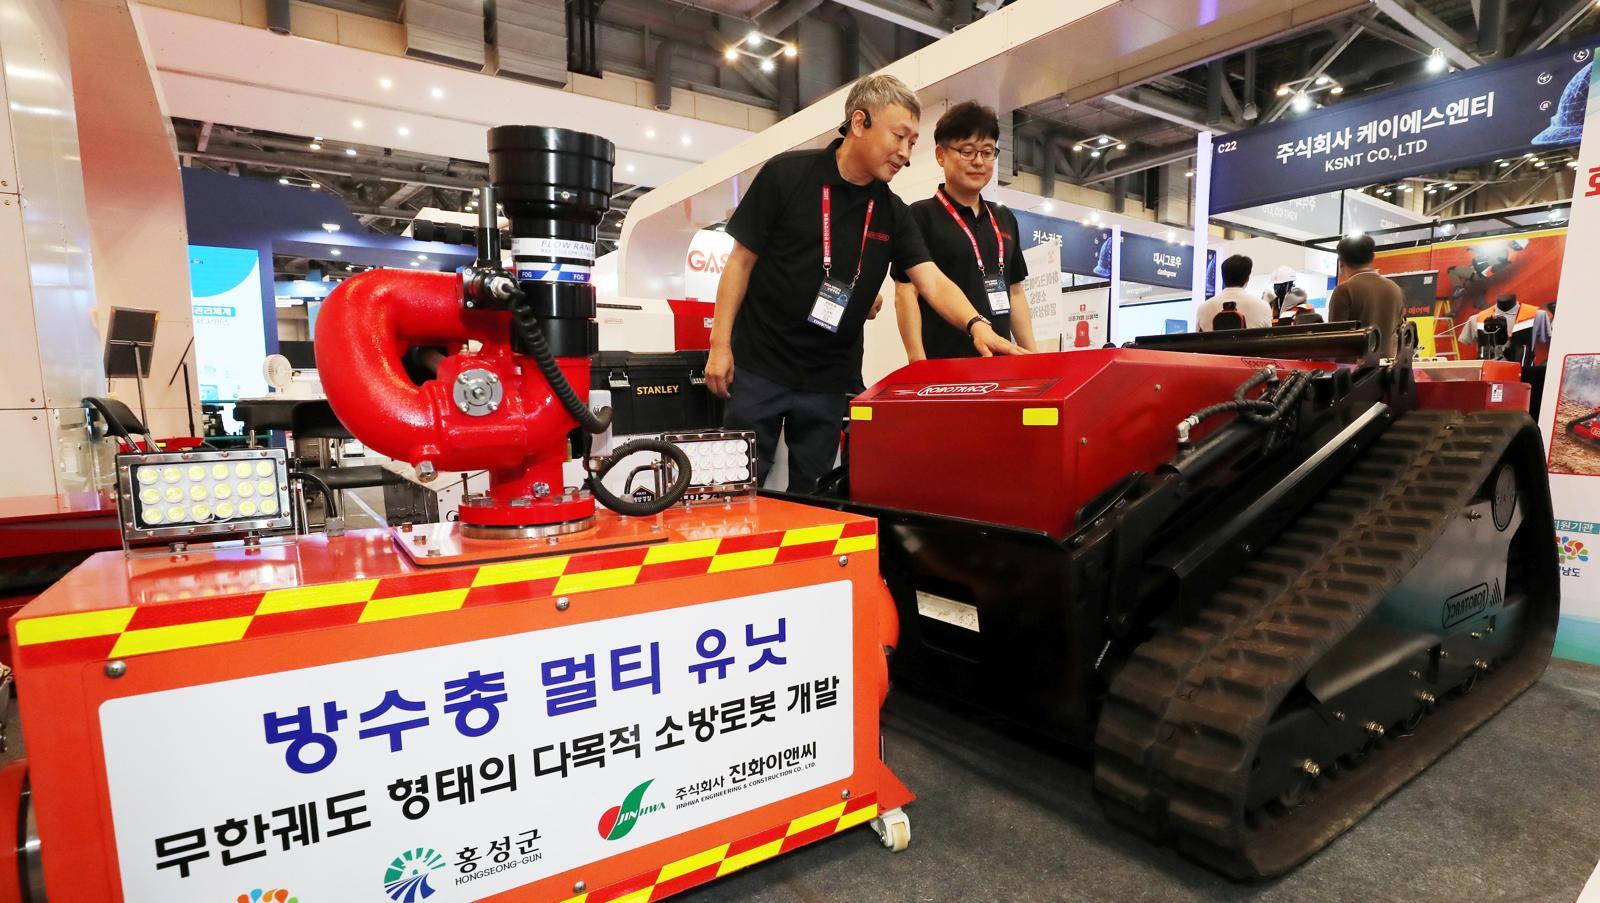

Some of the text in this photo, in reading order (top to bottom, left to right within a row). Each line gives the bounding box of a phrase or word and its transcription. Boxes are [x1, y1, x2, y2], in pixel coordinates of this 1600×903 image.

[1275, 91, 1496, 165] 주식회사 케이에스엔티
[1217, 140, 1238, 155] C22
[1324, 138, 1429, 173] KSNT CO.,LTD
[541, 239, 570, 249] FLOW
[636, 384, 680, 396] STANLEY
[924, 385, 988, 395] ROBOTRACK
[1558, 565, 1582, 578] 남도
[262, 616, 788, 775] 방수총 멀티 유닛
[155, 675, 841, 879] 무한궤도 형태의 다목적 소방로봇 개발
[674, 741, 817, 801] 주식회사 진화이앤씨
[675, 798, 700, 811] JINHWA
[700, 784, 742, 803] ENGINEERING
[742, 782, 748, 790] &
[748, 768, 793, 788] CONSTRUCTION
[617, 801, 666, 827] JINHWA
[453, 828, 543, 874] 홍성군
[454, 852, 543, 886] HONGSEONG-GUN
